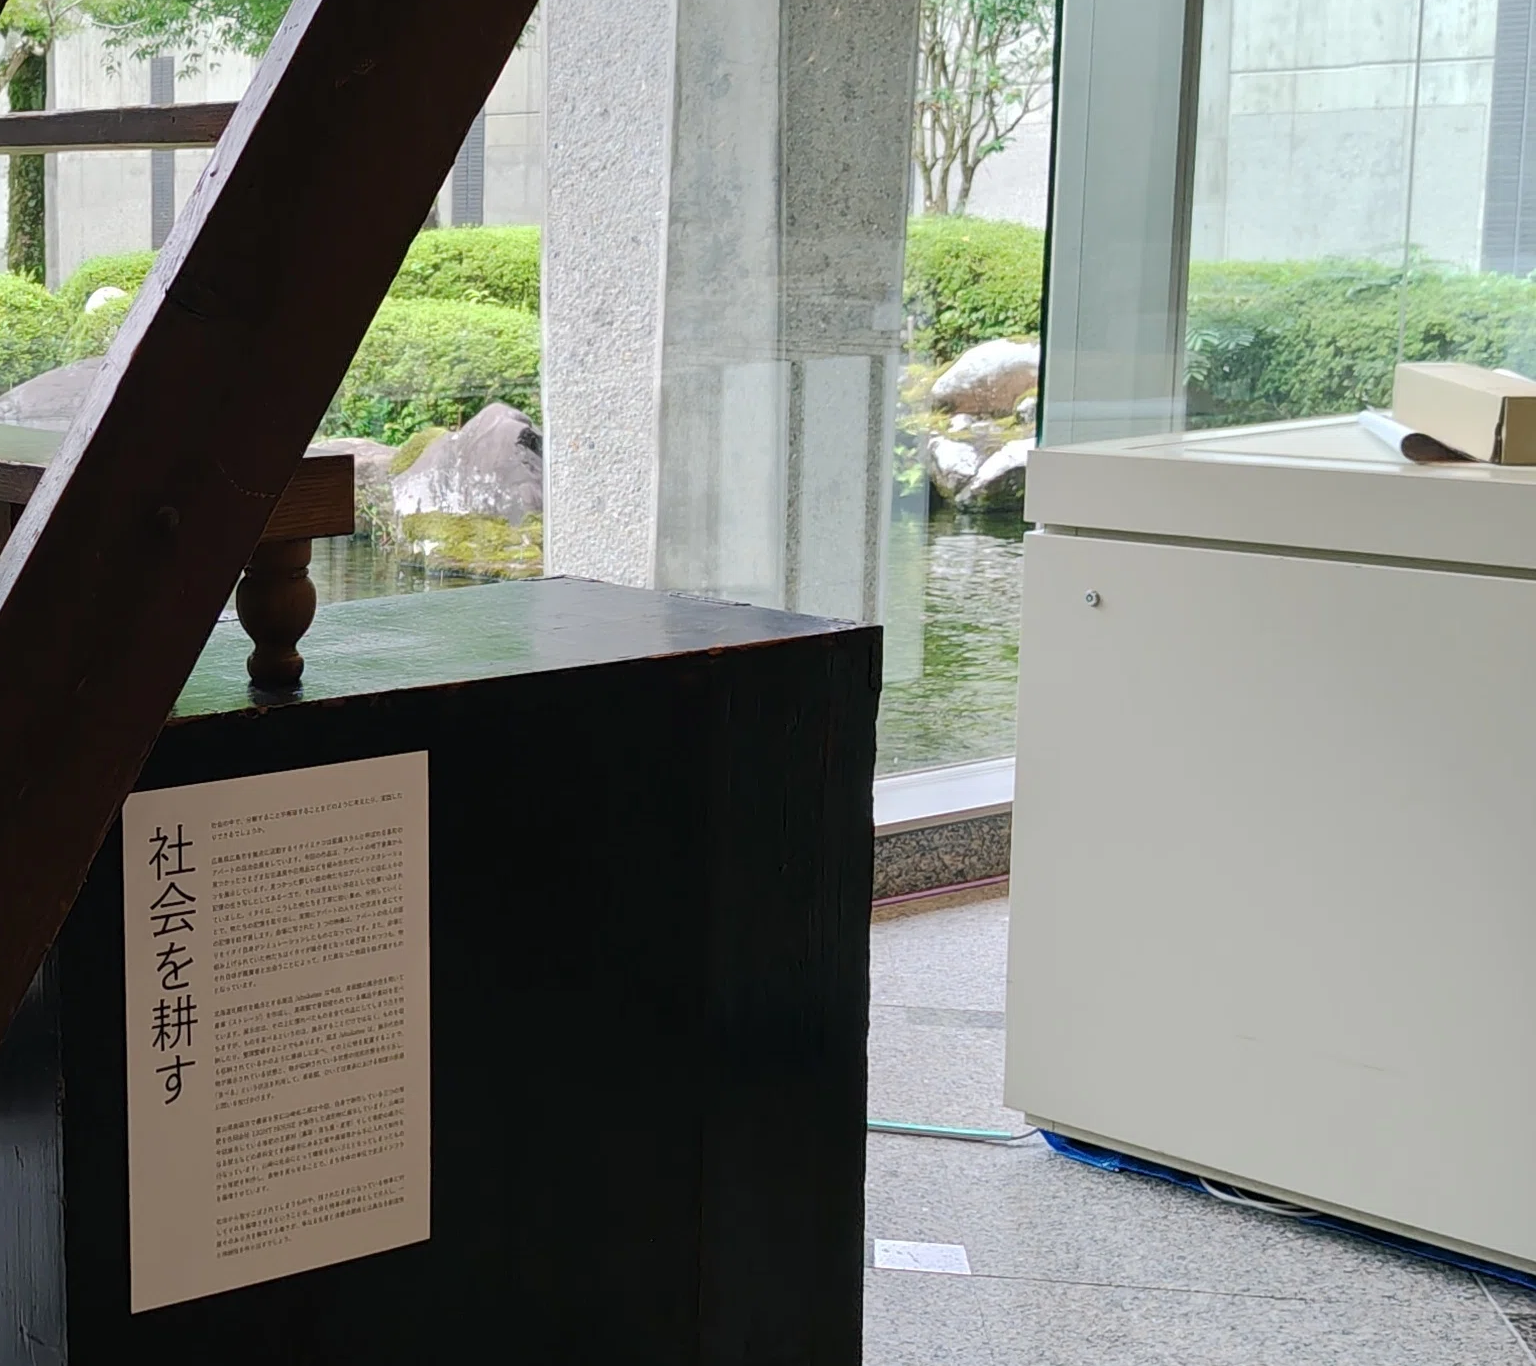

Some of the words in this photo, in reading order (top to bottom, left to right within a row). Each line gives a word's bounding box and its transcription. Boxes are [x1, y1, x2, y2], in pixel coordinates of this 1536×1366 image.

[148, 824, 199, 1105] 社会を耕す
